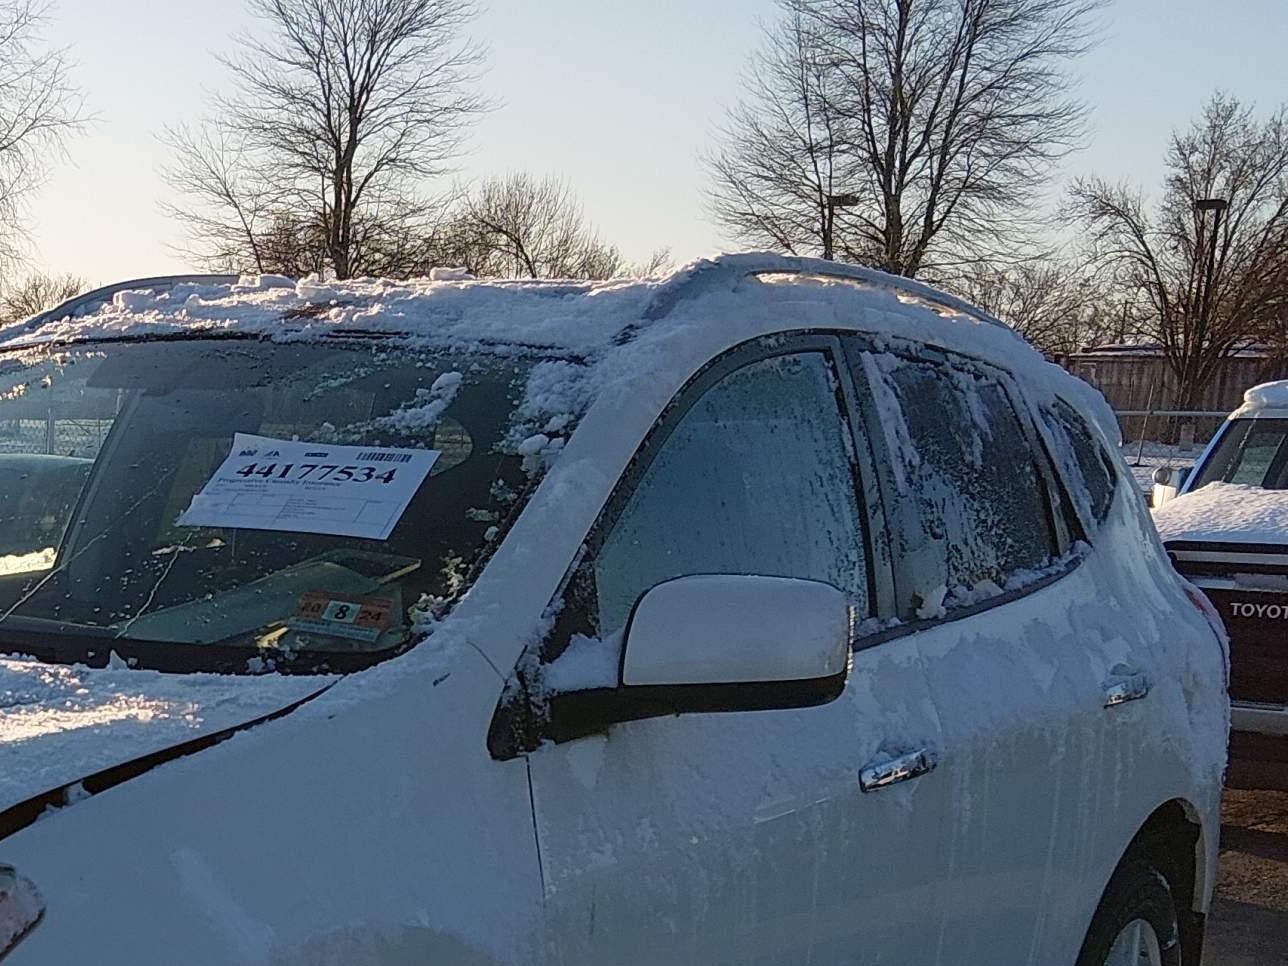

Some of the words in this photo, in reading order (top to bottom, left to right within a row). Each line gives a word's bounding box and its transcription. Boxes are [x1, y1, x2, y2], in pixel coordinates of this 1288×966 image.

[236, 462, 397, 484] 44177534
[334, 604, 350, 620] 8
[359, 609, 382, 621] 24
